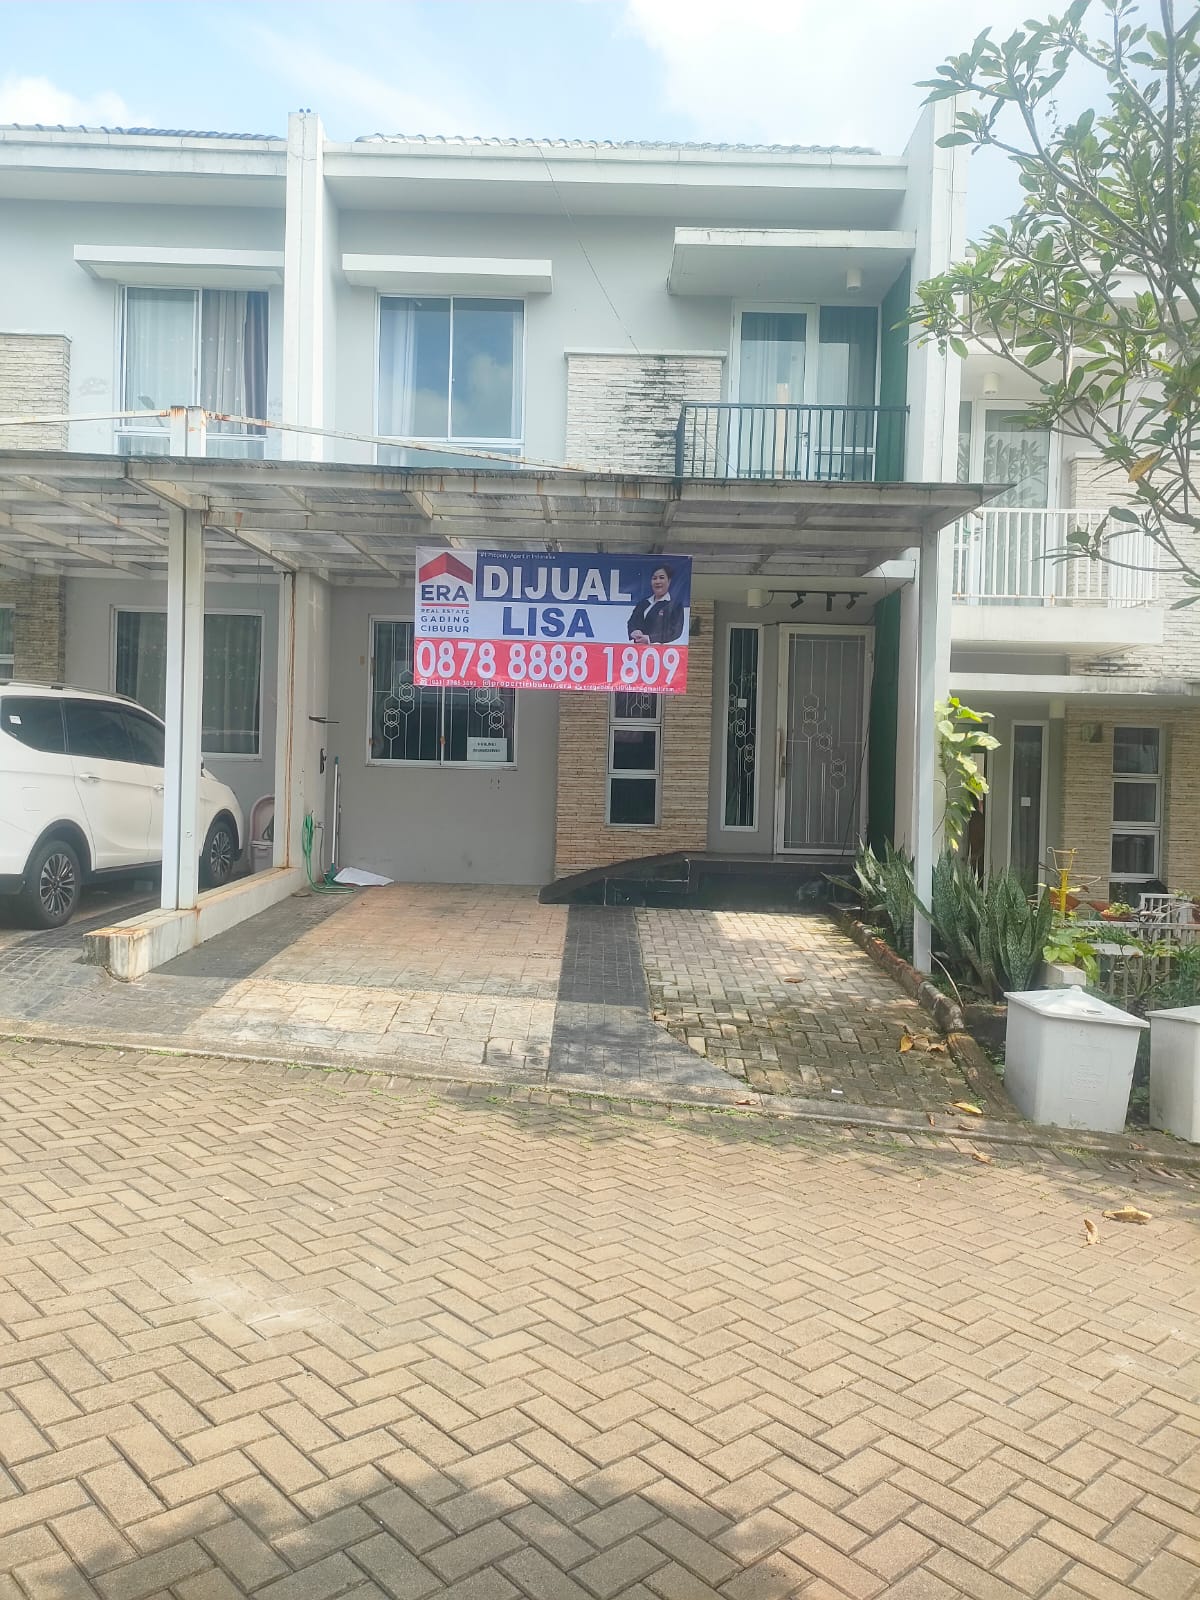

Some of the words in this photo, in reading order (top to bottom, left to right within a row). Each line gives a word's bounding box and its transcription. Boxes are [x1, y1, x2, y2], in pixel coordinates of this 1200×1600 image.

[421, 584, 470, 602] ERA
[482, 565, 632, 602] DIJUAL
[420, 615, 470, 624] GADING
[420, 624, 470, 633] CIBUBUR
[502, 606, 595, 639] LISA
[416, 640, 496, 679] 0878
[507, 643, 589, 683] 8888
[602, 646, 680, 685] 1809
